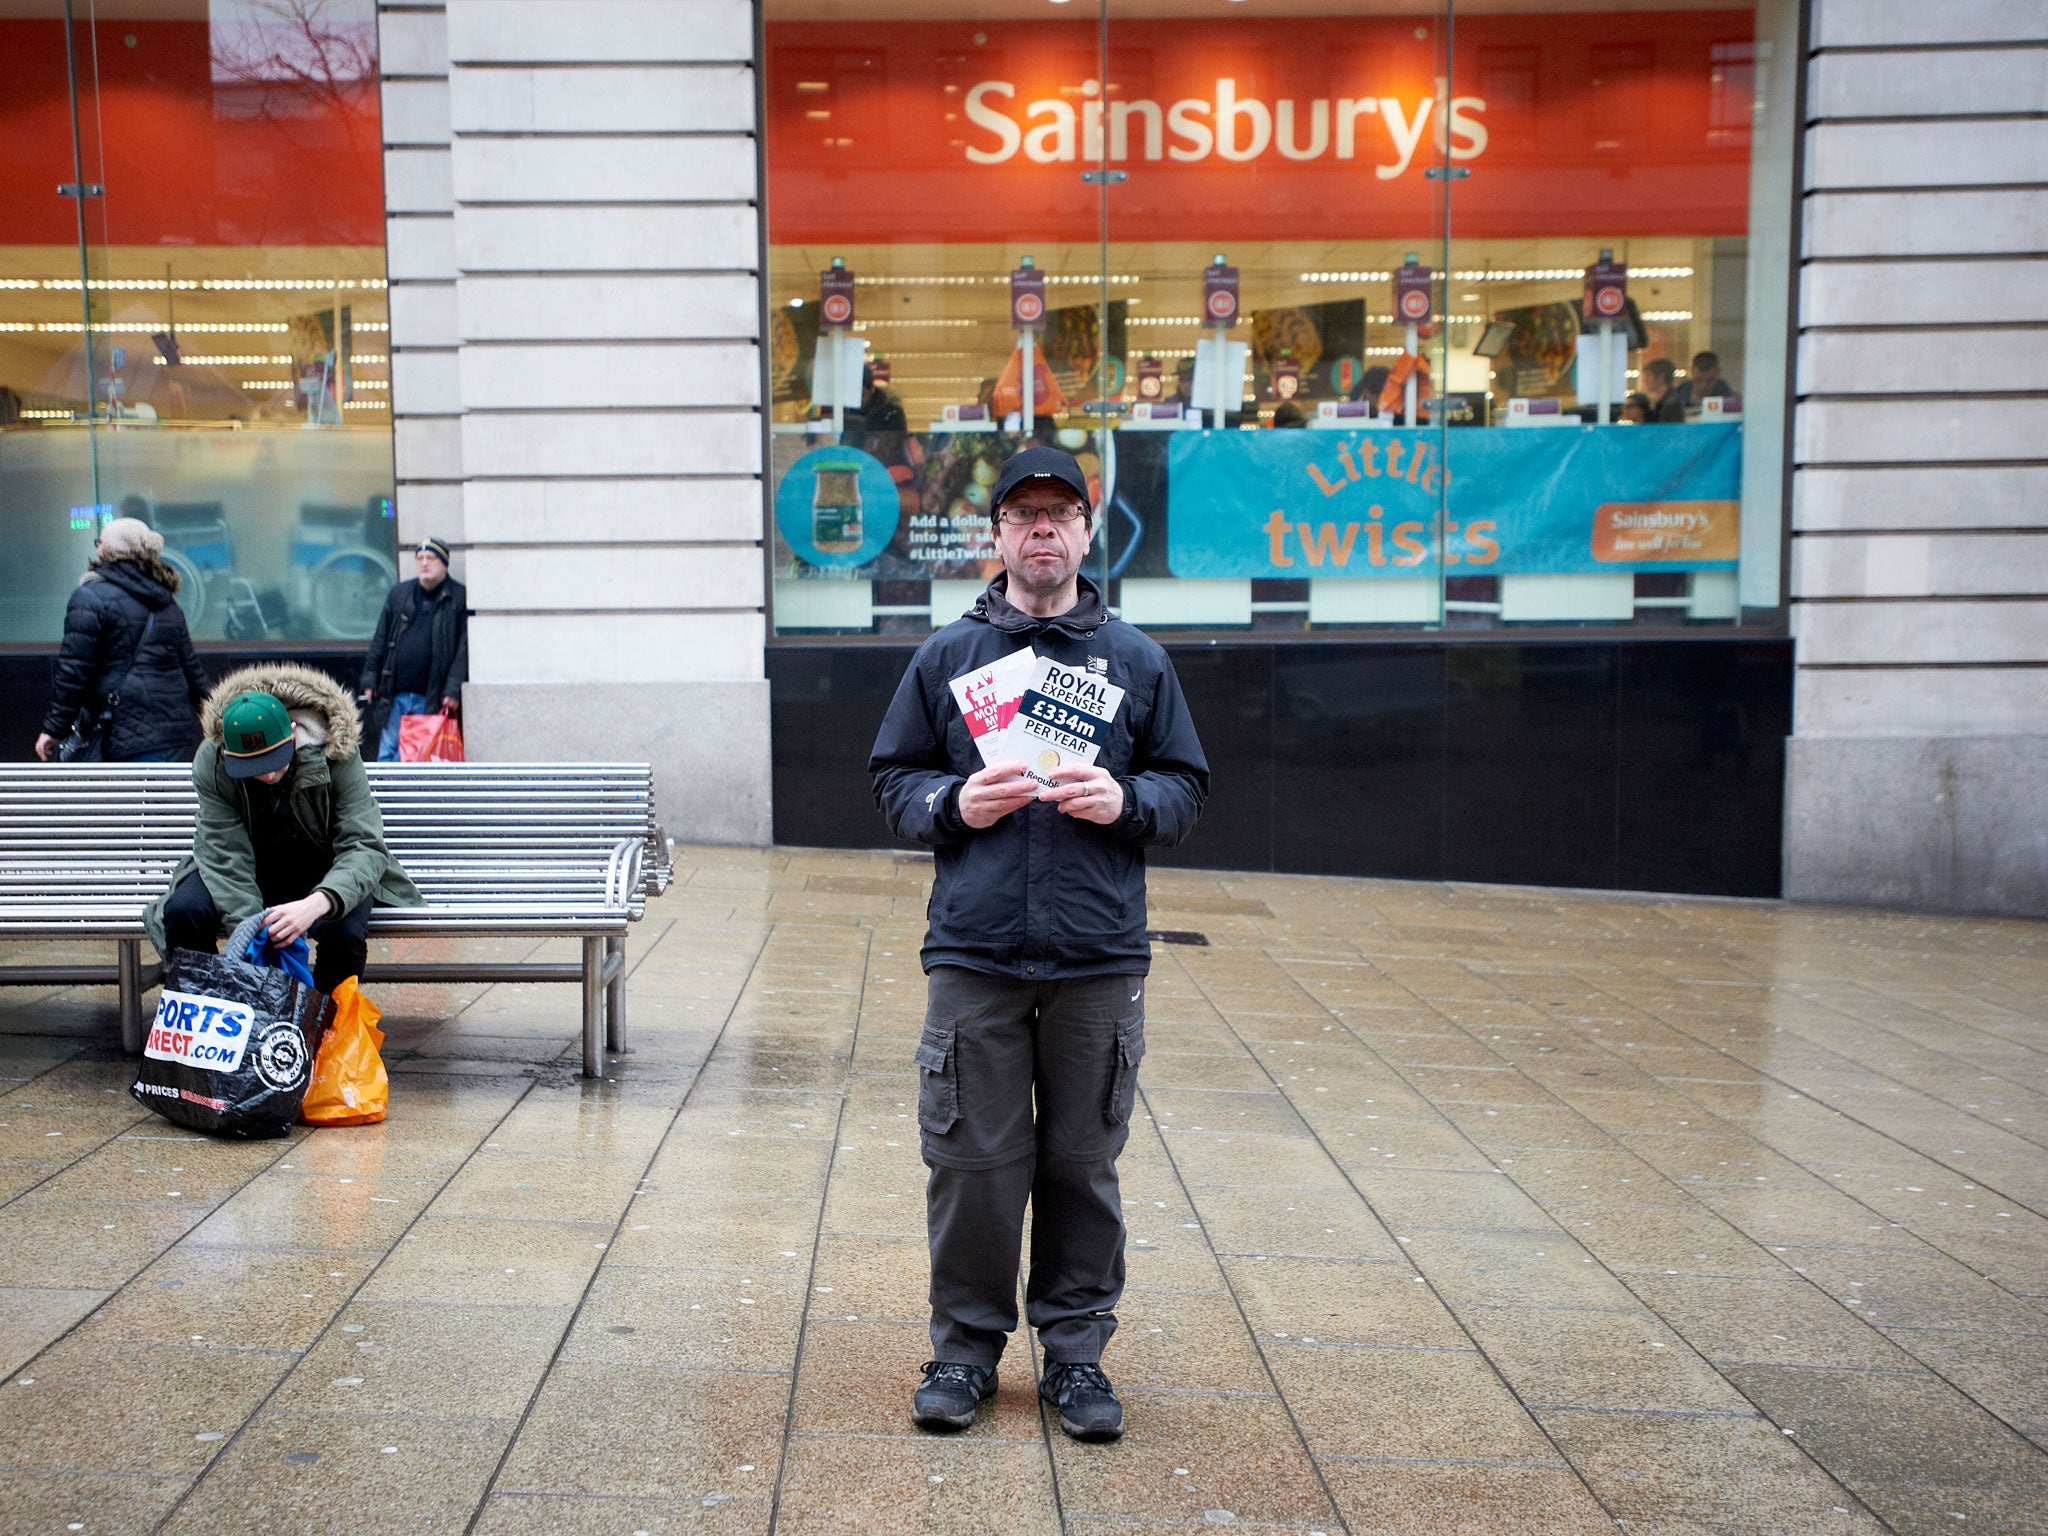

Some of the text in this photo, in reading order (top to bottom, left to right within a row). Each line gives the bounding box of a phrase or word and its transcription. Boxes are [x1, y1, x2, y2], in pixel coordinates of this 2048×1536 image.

[962, 77, 1489, 181] Sainsbury's
[1306, 437, 1453, 498] Little
[909, 514, 937, 528] Add
[939, 517, 949, 528] a
[1263, 505, 1501, 568] twists
[1611, 510, 1708, 531] Sainsbury's
[909, 530, 939, 543] into
[940, 532, 972, 546] your
[1041, 682, 1105, 716] EXPENSES
[1046, 666, 1107, 705] ROYAL
[1025, 719, 1051, 738] PER
[1053, 730, 1088, 753] YEAR
[1031, 700, 1096, 738] £334m
[1026, 771, 1060, 788] Republi
[158, 997, 247, 1037] PORTS
[145, 1084, 180, 1099] PRICES
